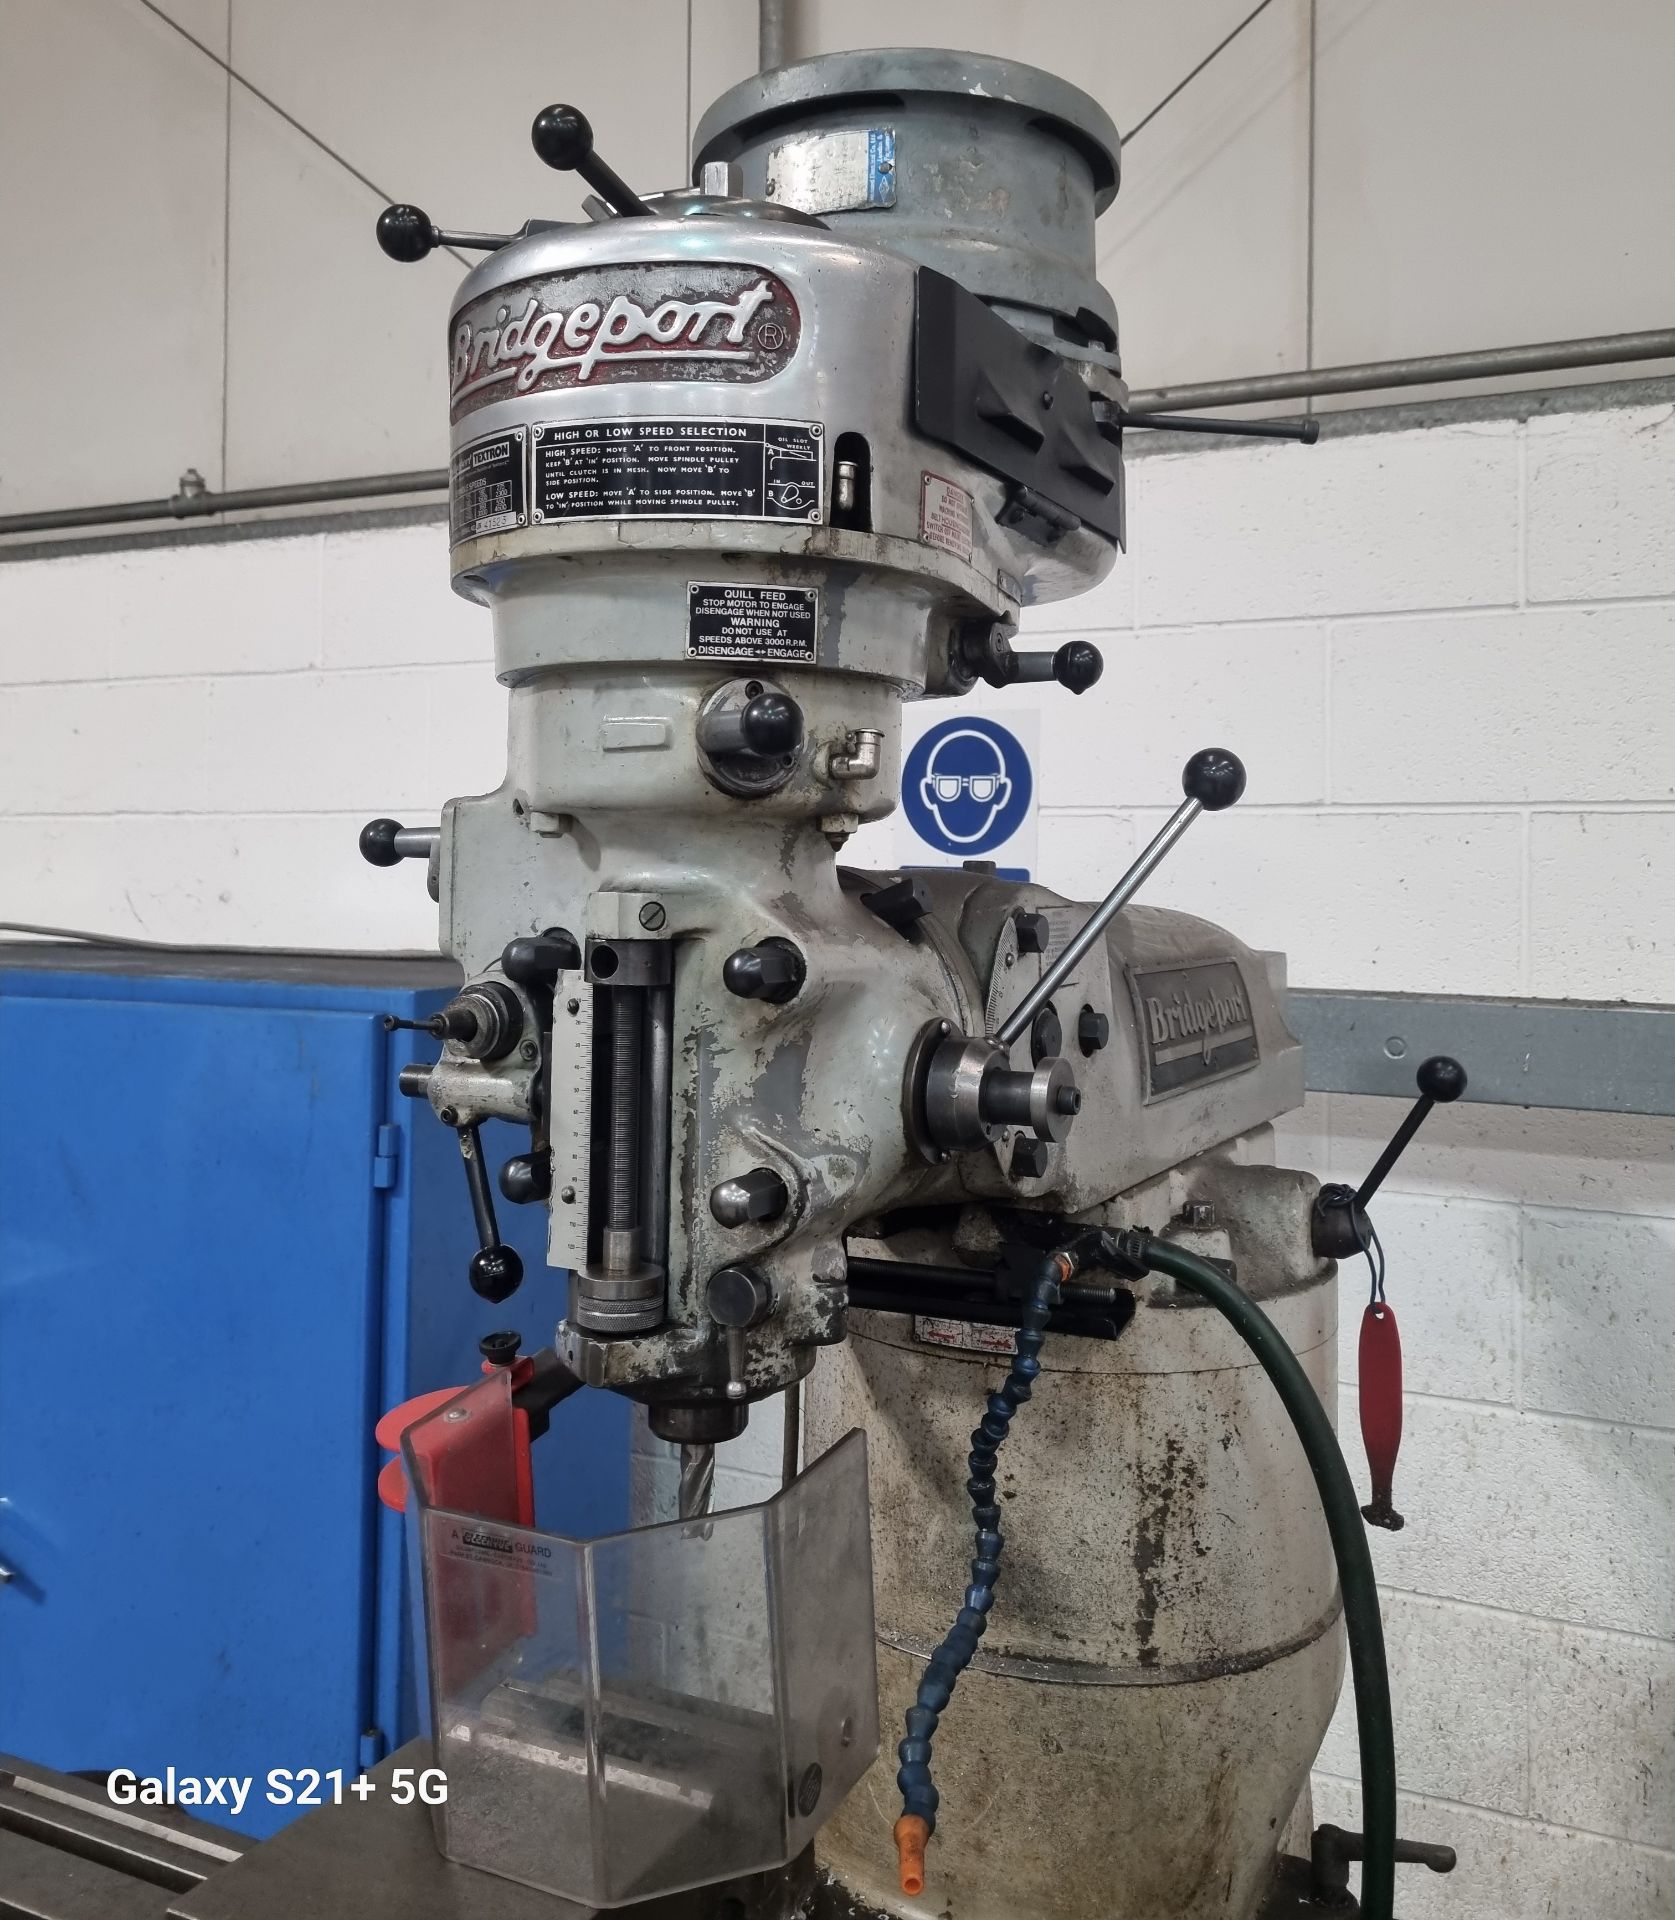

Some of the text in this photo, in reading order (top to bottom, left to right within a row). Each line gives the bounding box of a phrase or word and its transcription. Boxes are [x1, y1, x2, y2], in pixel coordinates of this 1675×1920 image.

[452, 279, 774, 391] Bridgeport
[554, 426, 747, 440] HIGH OR LOW SPEED SELECTION
[474, 444, 508, 462] TEXTRON
[545, 449, 566, 458] HIGH
[571, 446, 601, 455] SPEED:
[767, 448, 775, 456] A
[545, 460, 561, 468] KEEP
[545, 492, 564, 500] LOW
[568, 490, 599, 499] SPEED:
[571, 500, 604, 508] POSITION
[927, 521, 944, 533] SWITCH
[929, 532, 945, 543] BEFORE
[724, 590, 786, 600] QUILL FEED
[703, 599, 725, 607] STOP
[727, 600, 757, 608] MOTOR
[771, 602, 804, 611] ENGAGE
[695, 607, 811, 619] DISENGAGE WHEN NOT USED
[730, 617, 780, 628] WARNING
[722, 627, 734, 635] DO
[699, 636, 808, 647] SPEEDS ABOVE 3000 R.P.M.
[698, 646, 806, 658] DISENGAGE ENGAGE
[1146, 984, 1248, 1065] Bridgeport
[451, 1530, 458, 1539] A
[515, 1542, 552, 1558] GUARD
